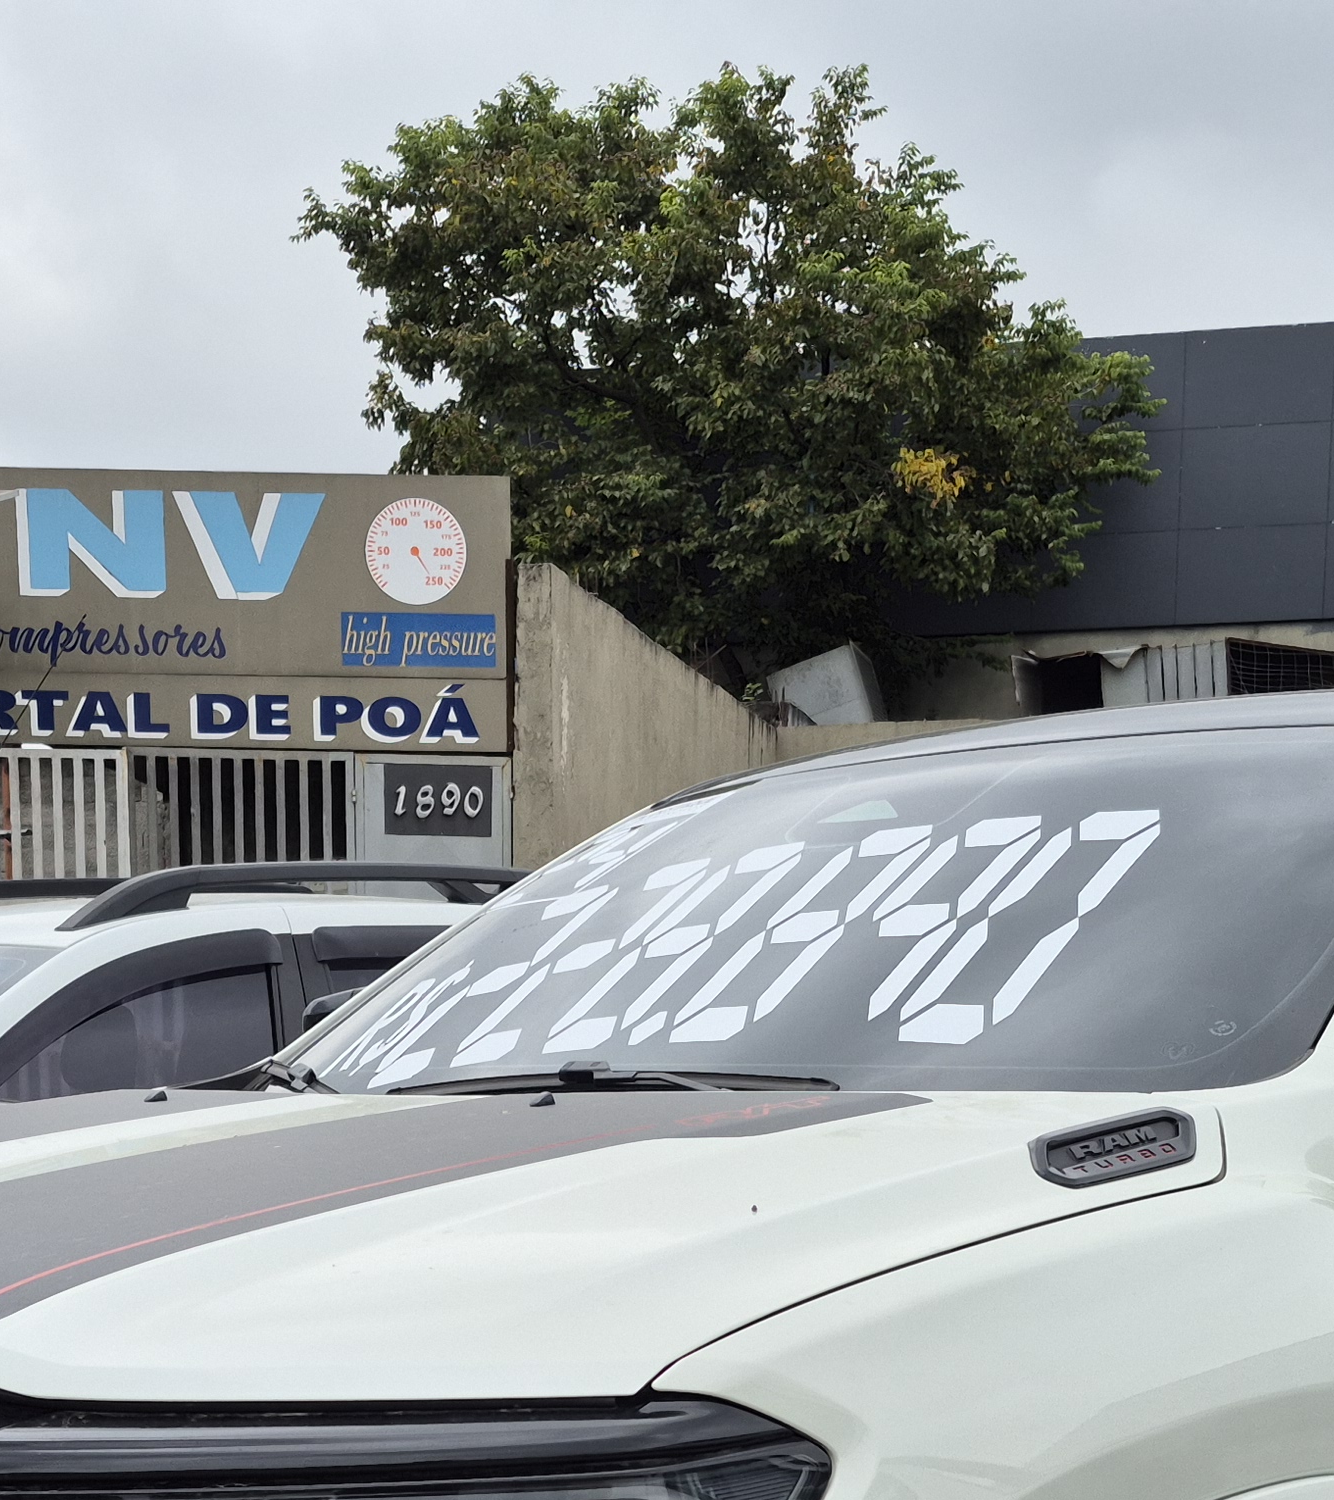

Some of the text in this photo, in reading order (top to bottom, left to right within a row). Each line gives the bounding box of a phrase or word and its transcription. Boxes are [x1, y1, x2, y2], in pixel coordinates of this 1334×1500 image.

[389, 517, 408, 527] 100
[423, 519, 443, 529] 150
[377, 546, 390, 556] 50
[433, 547, 453, 557] 200
[425, 576, 443, 586] 250
[342, 614, 496, 667] high pressure
[188, 692, 292, 743] DE
[313, 683, 480, 745] POÁ
[394, 782, 485, 819] 1890
[1069, 1126, 1158, 1162] RAM
[1072, 1142, 1177, 1174] TURBO
